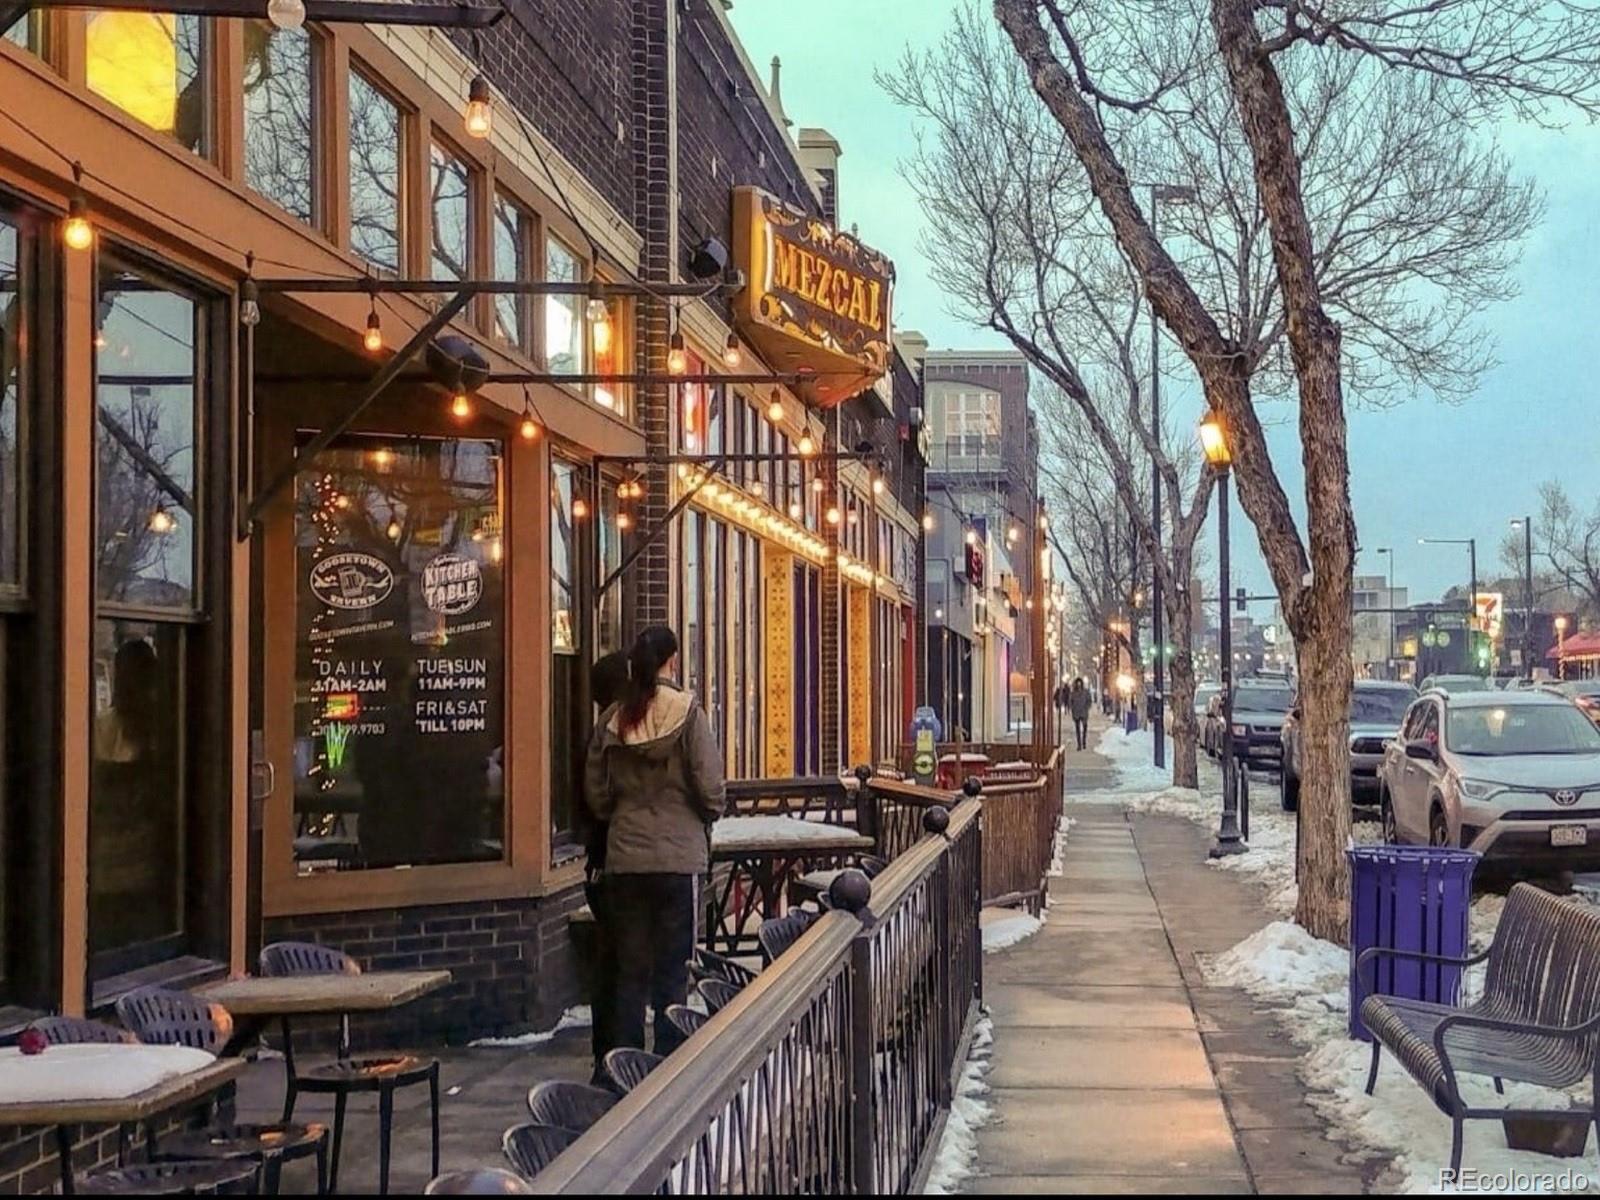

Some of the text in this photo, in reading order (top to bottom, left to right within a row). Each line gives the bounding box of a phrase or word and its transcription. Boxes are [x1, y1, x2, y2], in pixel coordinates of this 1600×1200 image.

[774, 236, 882, 332] MEZCAL
[424, 559, 479, 587] KITCHEN
[330, 593, 377, 607] TAVERN
[424, 579, 478, 610] TABLE
[320, 660, 383, 676] DAILY
[418, 676, 487, 691] 11AM-9PM
[416, 699, 488, 716] FRI&SAT
[450, 717, 486, 732] 10PM
